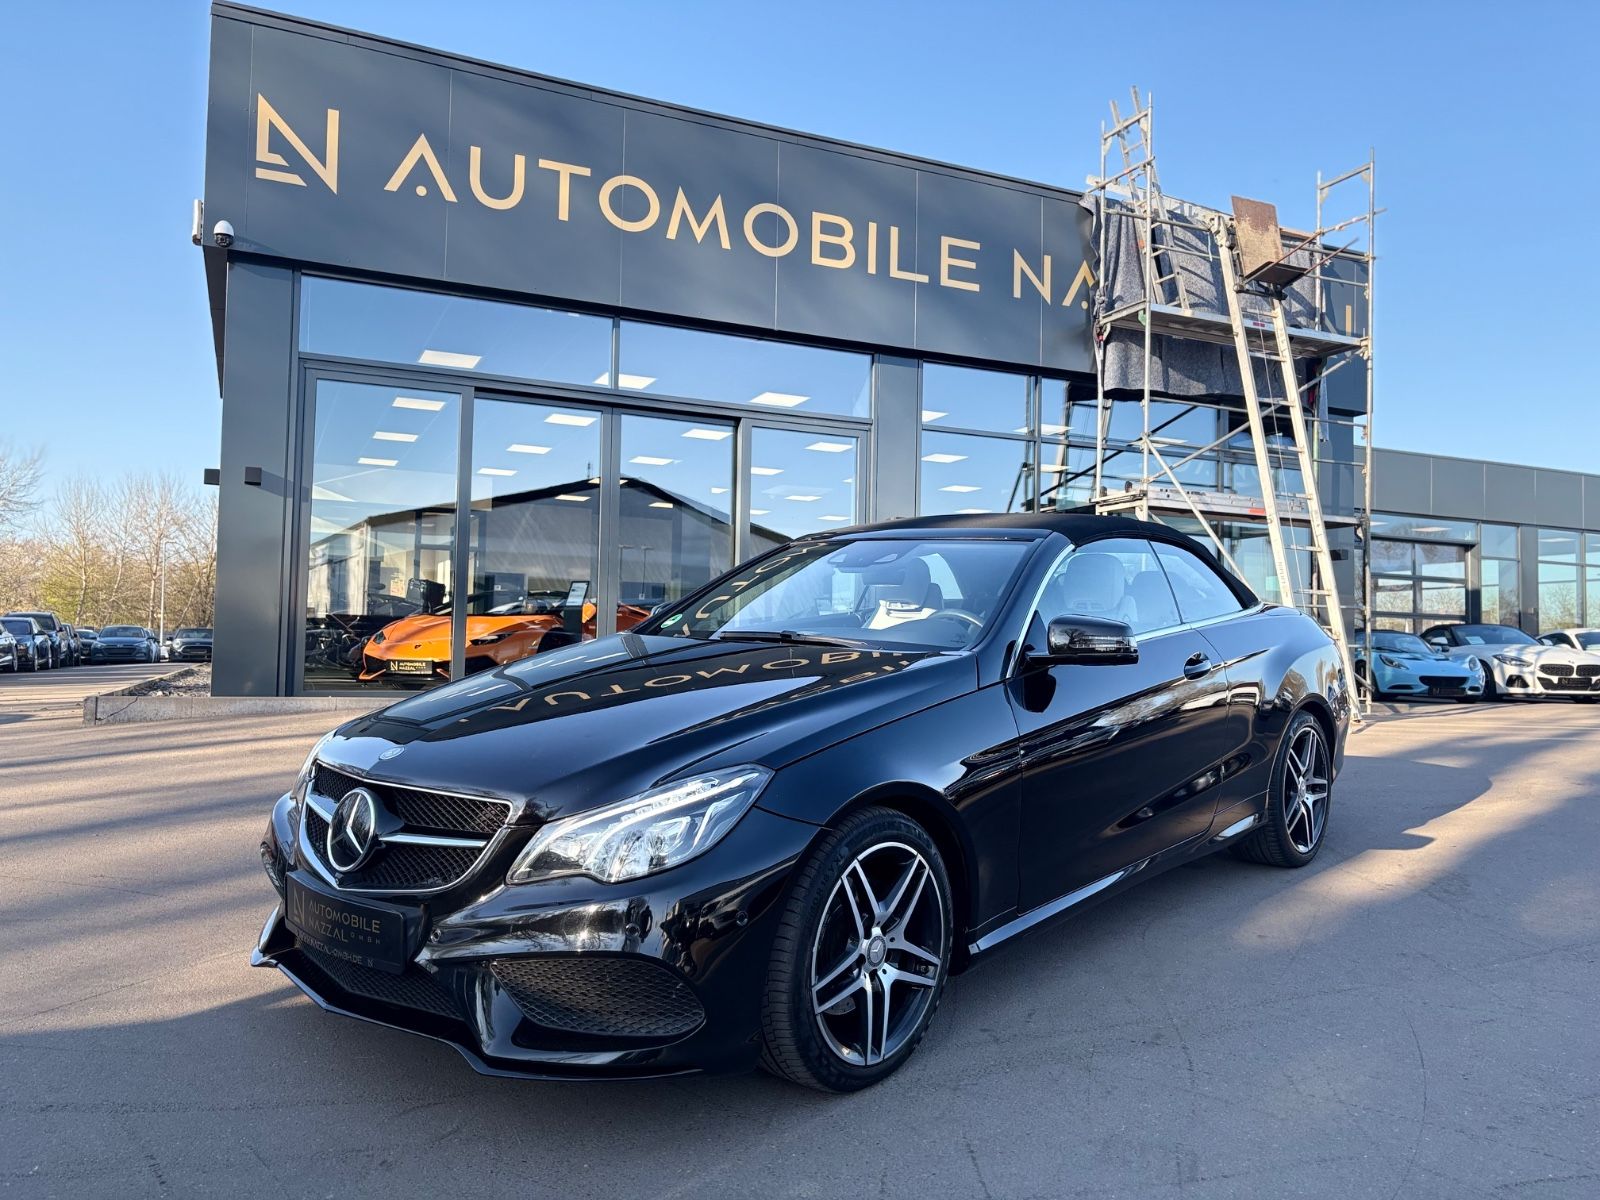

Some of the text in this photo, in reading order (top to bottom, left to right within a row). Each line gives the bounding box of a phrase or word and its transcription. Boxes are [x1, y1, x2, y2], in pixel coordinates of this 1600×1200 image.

[384, 133, 981, 293] AUTOMOBILE
[308, 900, 381, 933] AUTOMOBILE
[308, 917, 349, 943] NAZZAL
